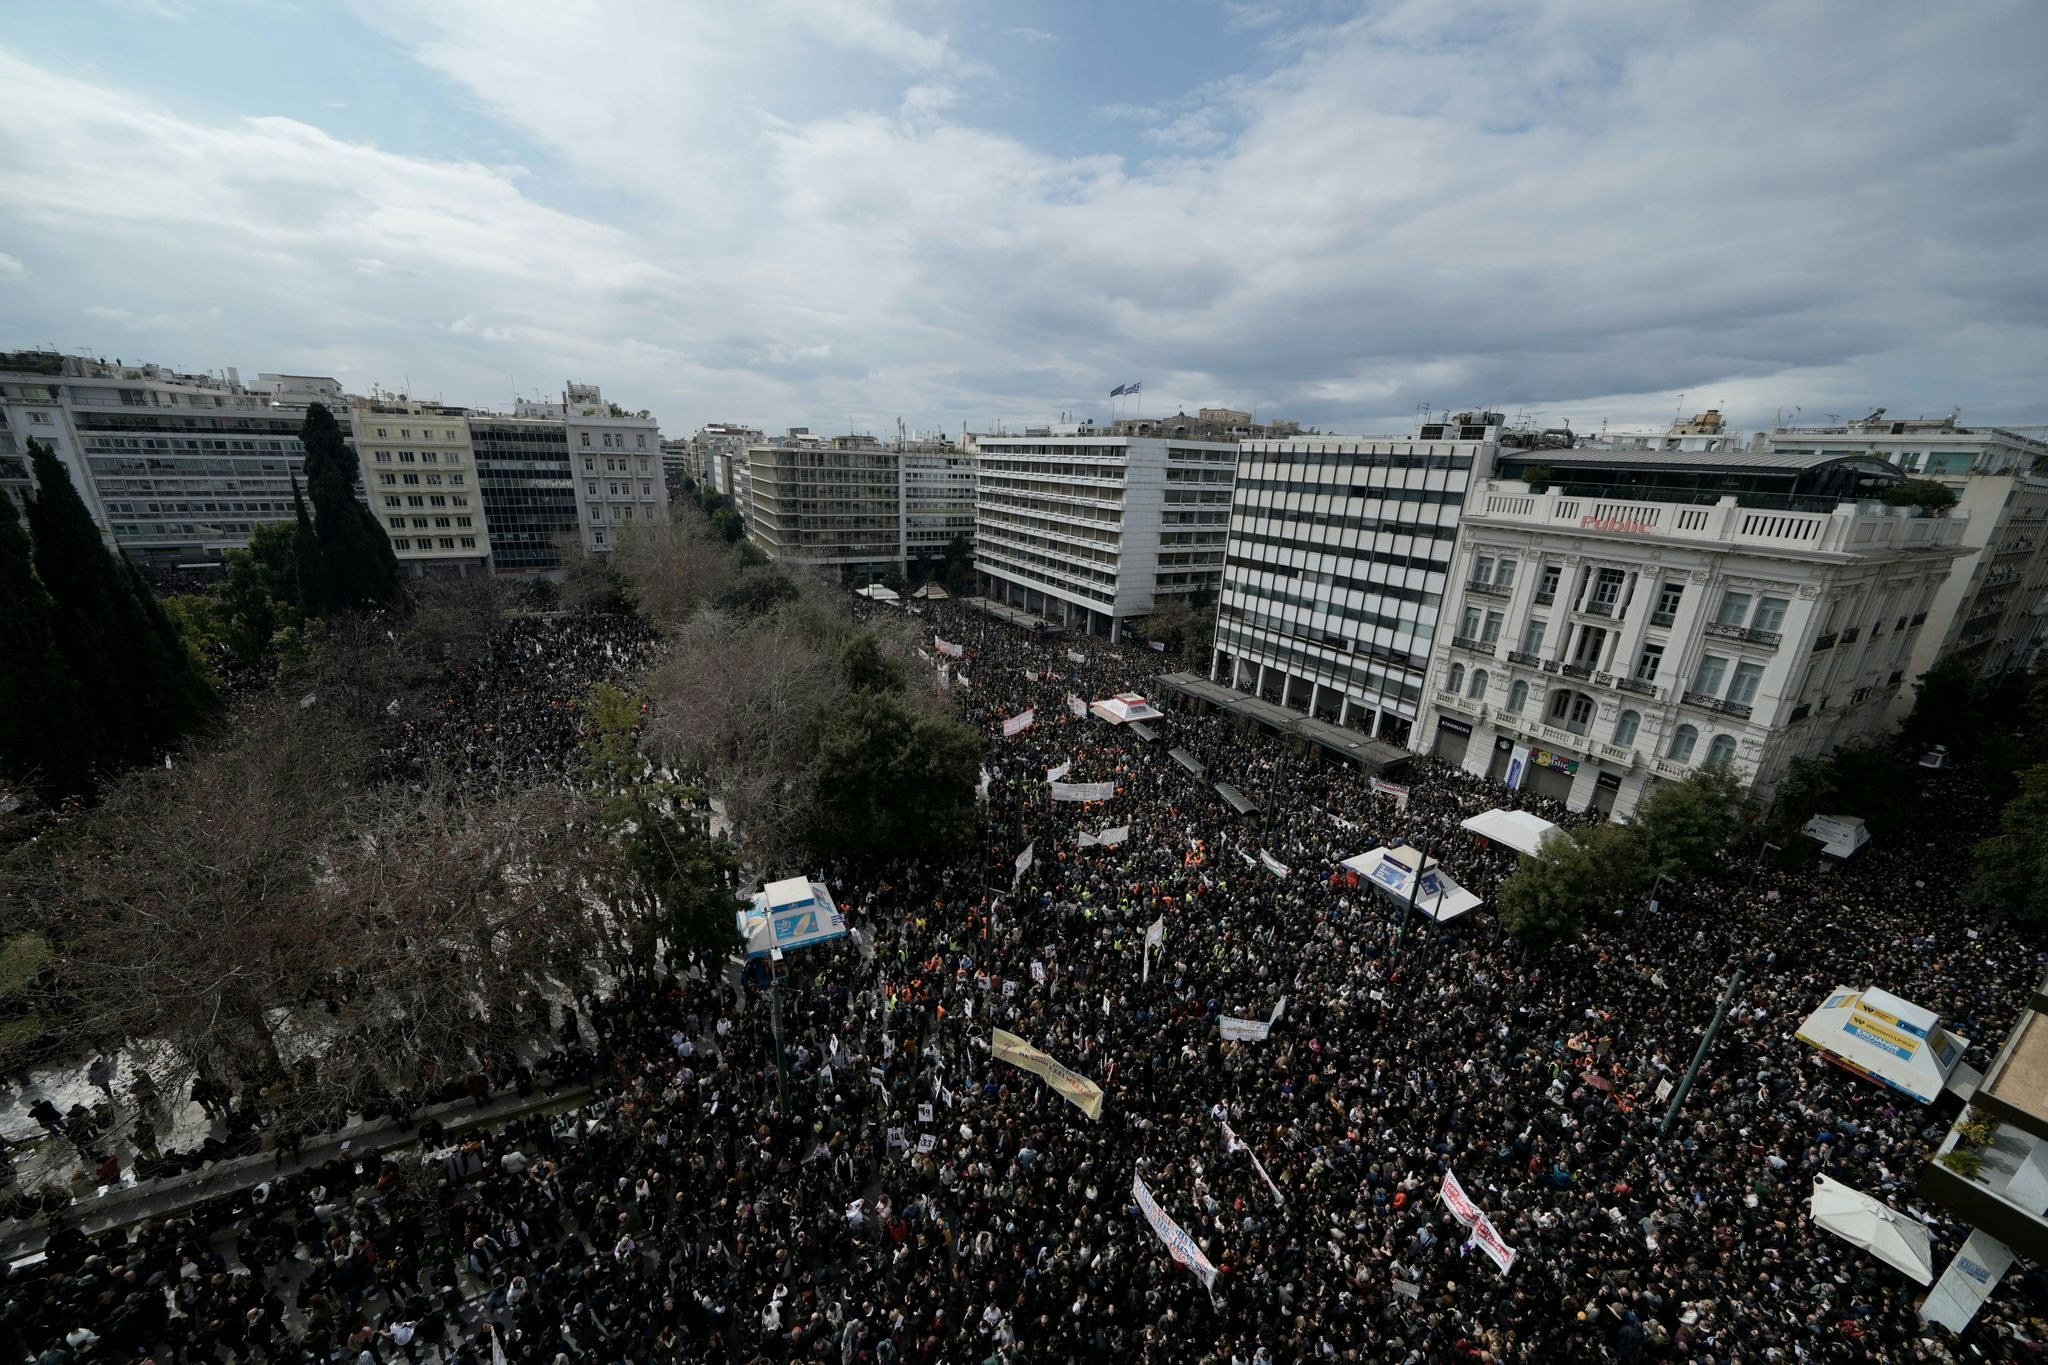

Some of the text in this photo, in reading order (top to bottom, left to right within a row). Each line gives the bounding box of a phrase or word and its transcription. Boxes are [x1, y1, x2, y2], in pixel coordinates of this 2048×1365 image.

[1580, 515, 1653, 535] Public
[1440, 720, 1470, 734] STARBUCKS
[1856, 1028, 1901, 1052] EXCHANGE
[1866, 1023, 1894, 1040] Western
[1894, 1036, 1915, 1049] Union
